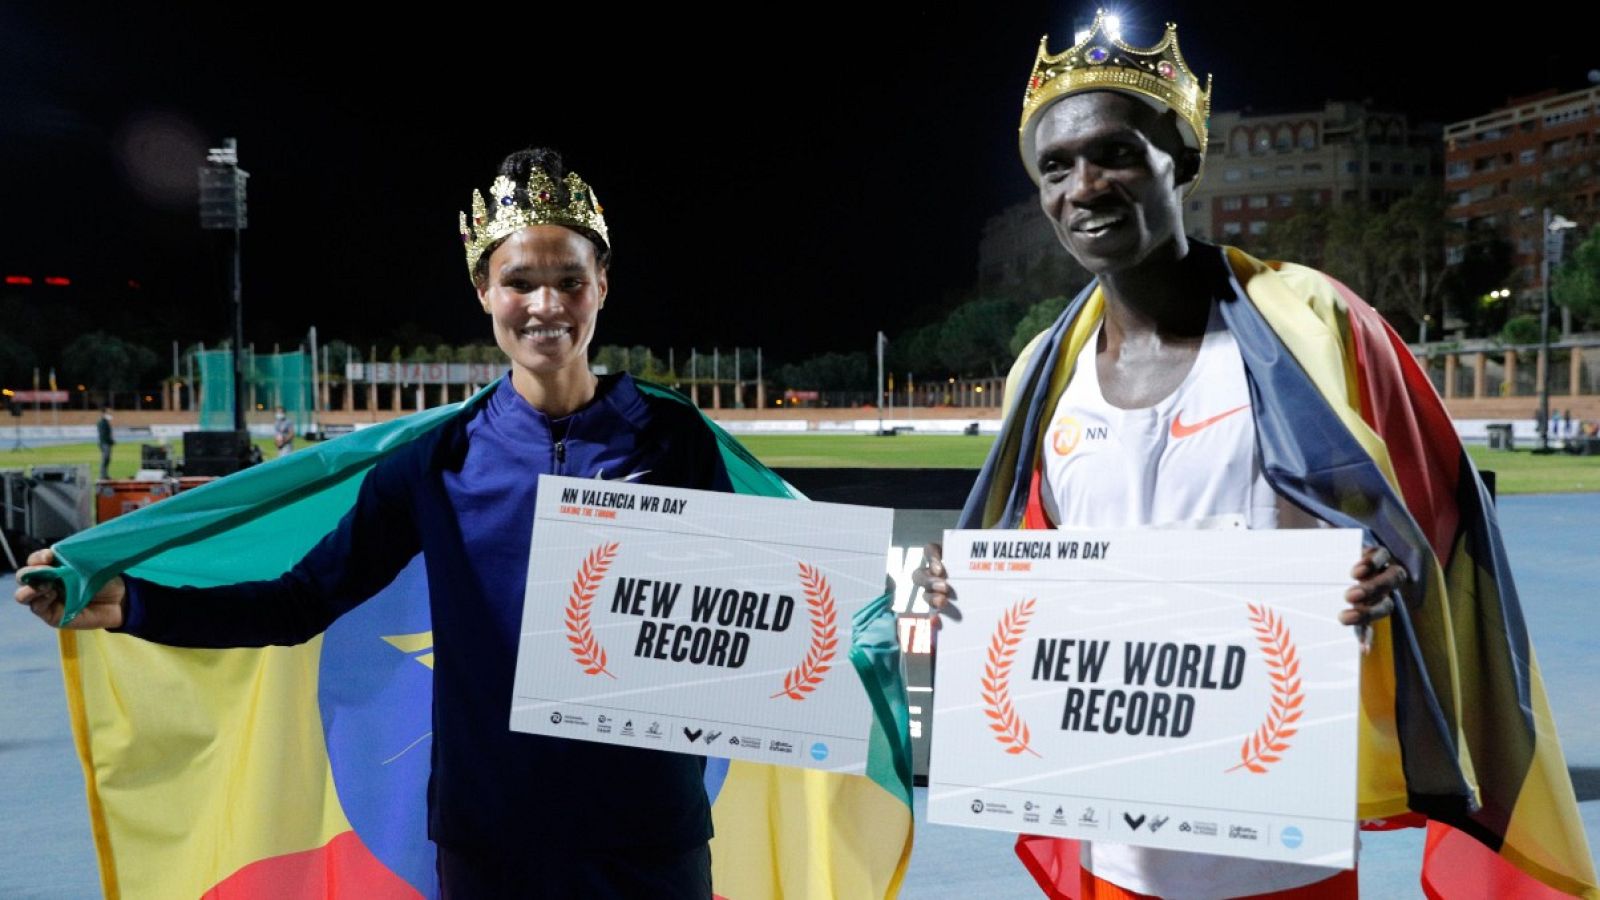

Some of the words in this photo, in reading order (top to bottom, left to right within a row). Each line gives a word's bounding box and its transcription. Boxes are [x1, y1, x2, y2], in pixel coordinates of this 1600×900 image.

[1085, 427, 1108, 440] NN
[561, 487, 579, 504] NN
[581, 489, 635, 510] VALENCIA
[640, 495, 661, 513] WR
[662, 497, 688, 515] DAY
[970, 541, 988, 558] NN
[993, 541, 1051, 559] VALENCIA
[1057, 541, 1079, 559] WR
[1082, 541, 1110, 559] DAY
[610, 577, 683, 619] NEW
[691, 585, 795, 632] WORLD
[634, 620, 751, 669] RECORD
[1031, 638, 1111, 683] NEW
[1124, 641, 1246, 690] WORLD
[1061, 687, 1196, 738] RECORD
